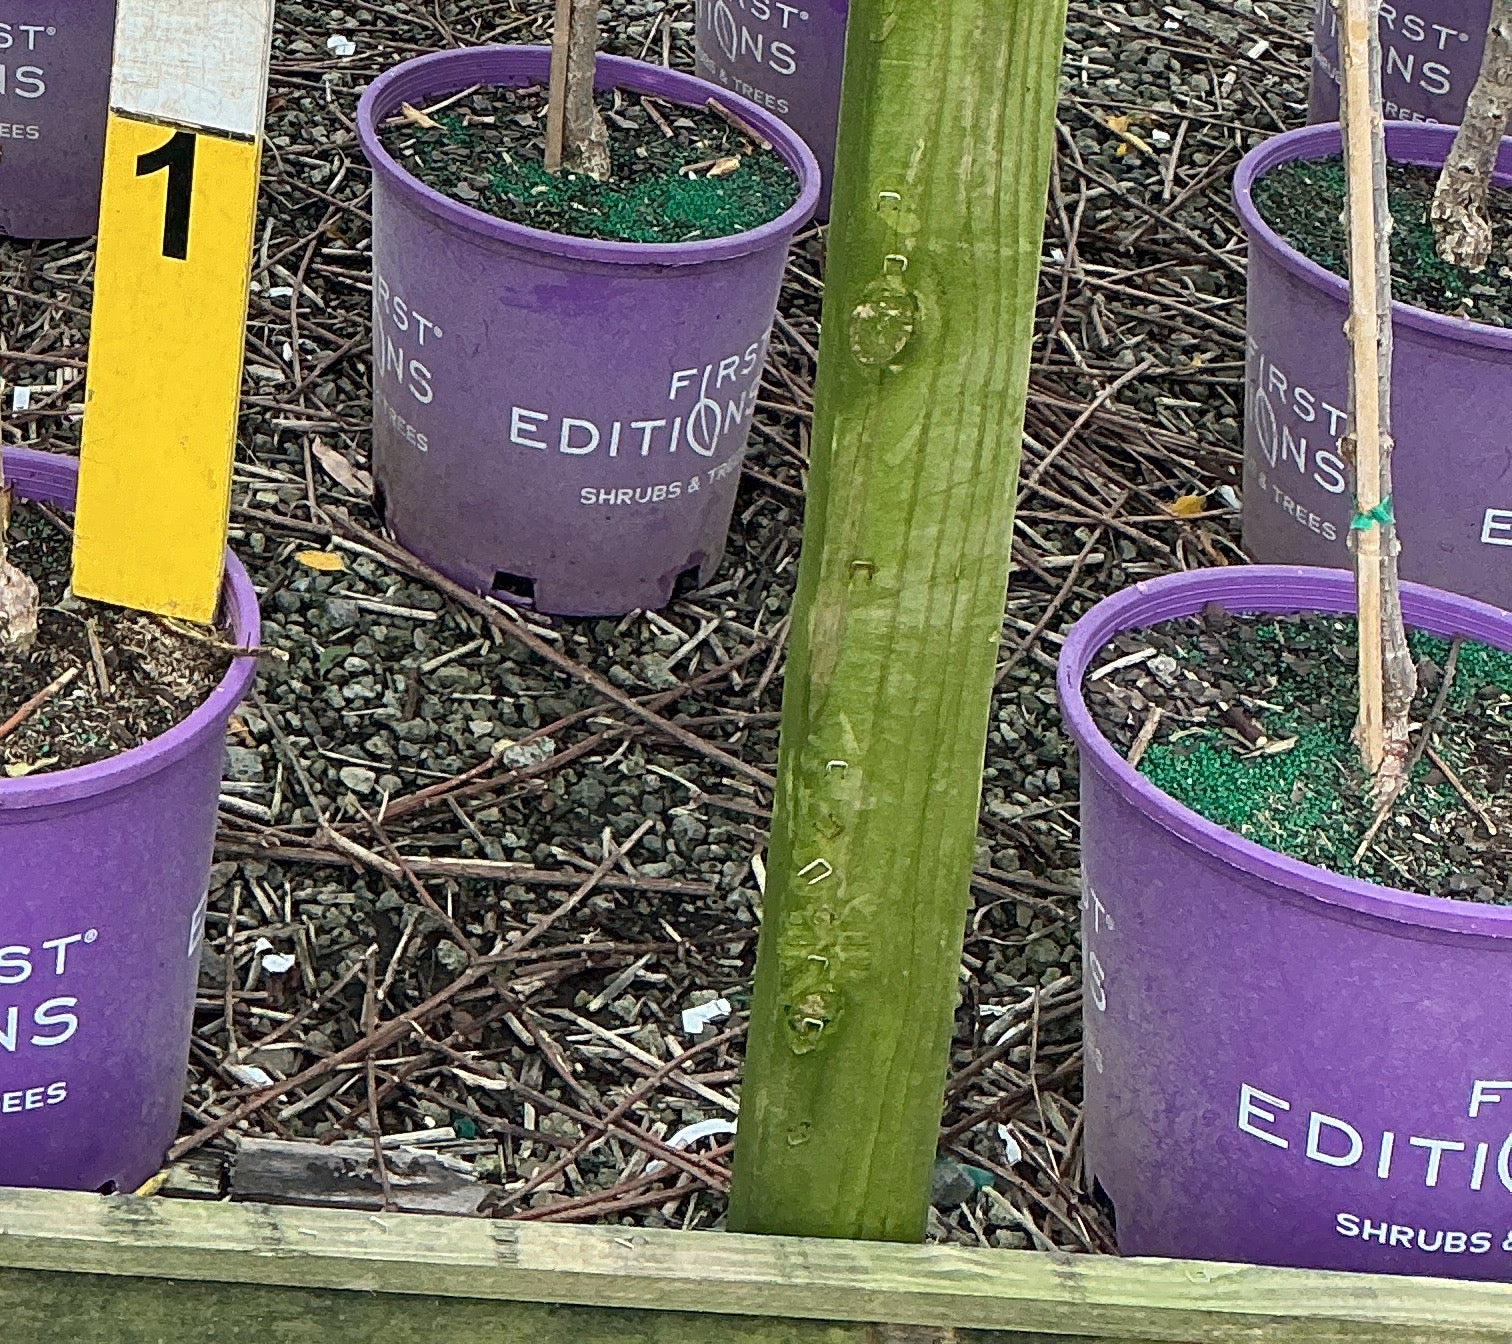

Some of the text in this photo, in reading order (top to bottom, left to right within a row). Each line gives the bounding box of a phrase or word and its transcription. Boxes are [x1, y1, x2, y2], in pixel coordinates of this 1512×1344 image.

[733, 75, 789, 114] TREES
[136, 131, 196, 261] 1
[377, 274, 443, 346] RST
[580, 476, 701, 505] SHRUBS &
[1273, 484, 1337, 541] TREES
[1238, 1082, 1512, 1195] EDITI
[1336, 1212, 1492, 1254] SHRUBS
